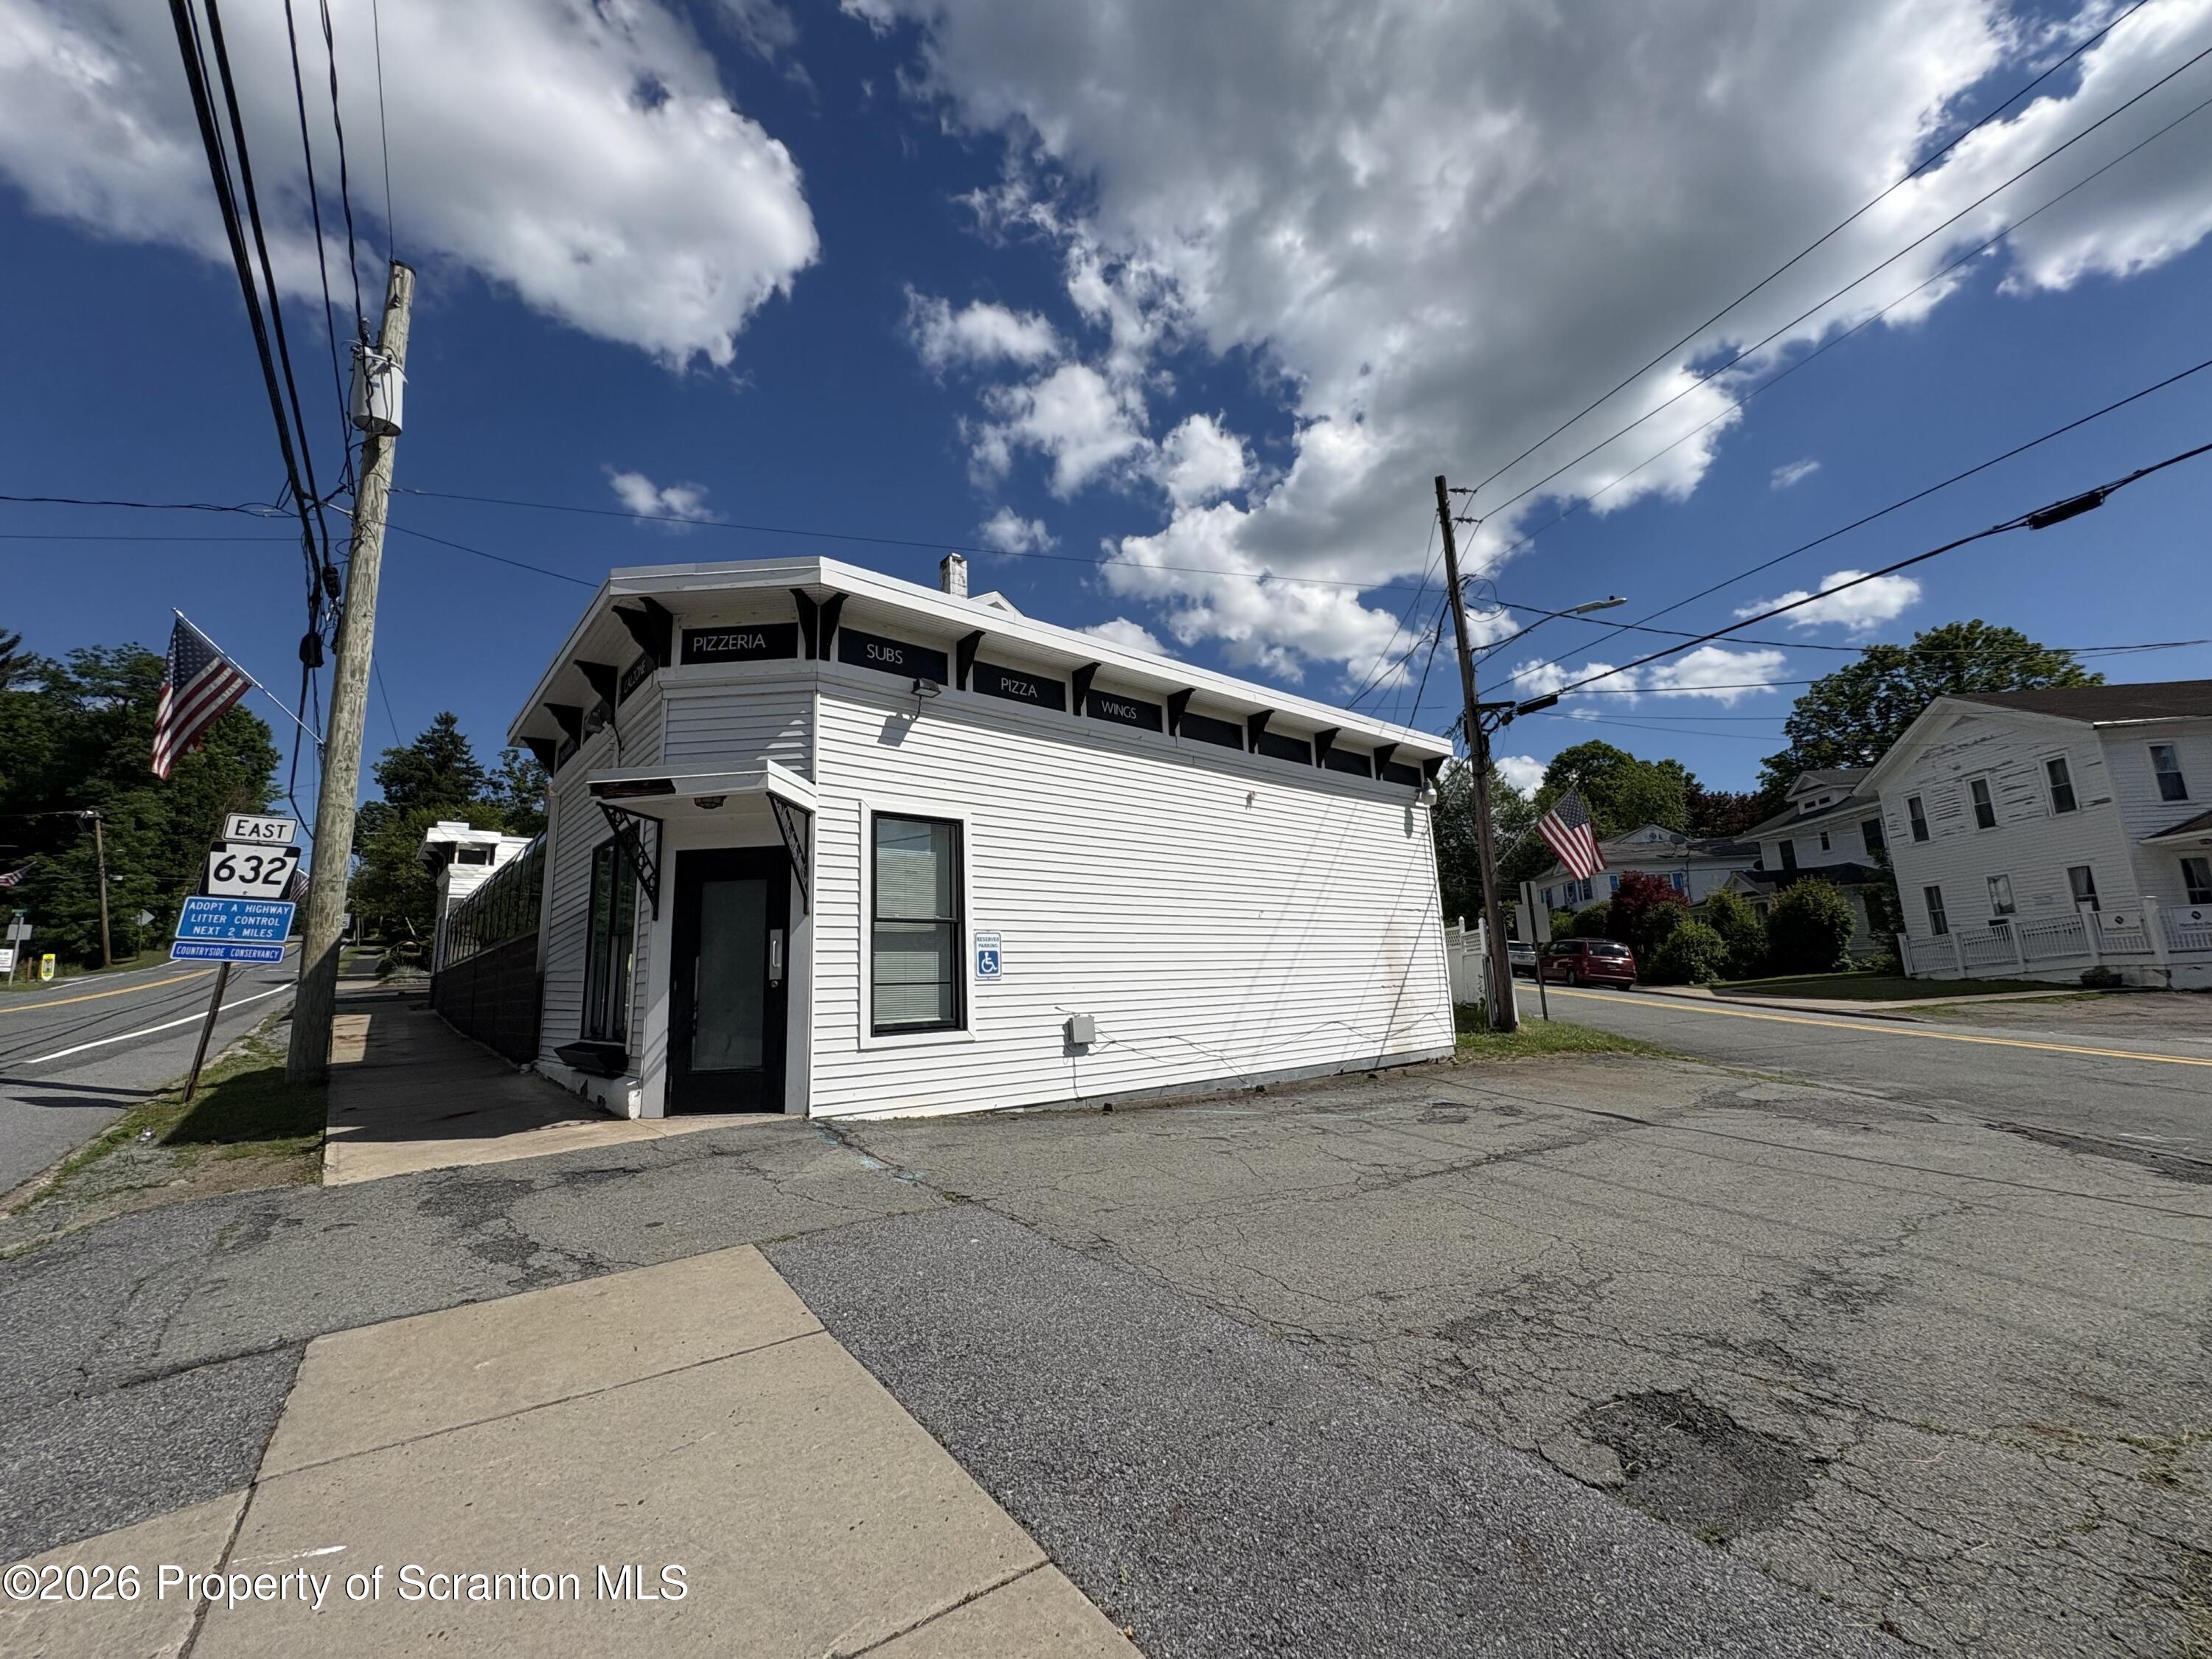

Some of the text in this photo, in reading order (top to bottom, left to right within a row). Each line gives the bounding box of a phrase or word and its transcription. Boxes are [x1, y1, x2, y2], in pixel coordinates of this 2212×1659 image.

[693, 633, 766, 652] PIZZERIA
[866, 644, 903, 664] SUBS
[1001, 677, 1037, 698] PIZZA
[1102, 700, 1137, 719] WINGS
[234, 819, 287, 839] EAST
[213, 854, 287, 886] 632
[189, 902, 290, 915] ADOPT A HIGHWAY
[191, 914, 280, 926] LITTER CONTROL
[193, 926, 274, 937] NEXT 2 MILES
[176, 946, 279, 959] COUNTRYSIDE CONSERVANCY
